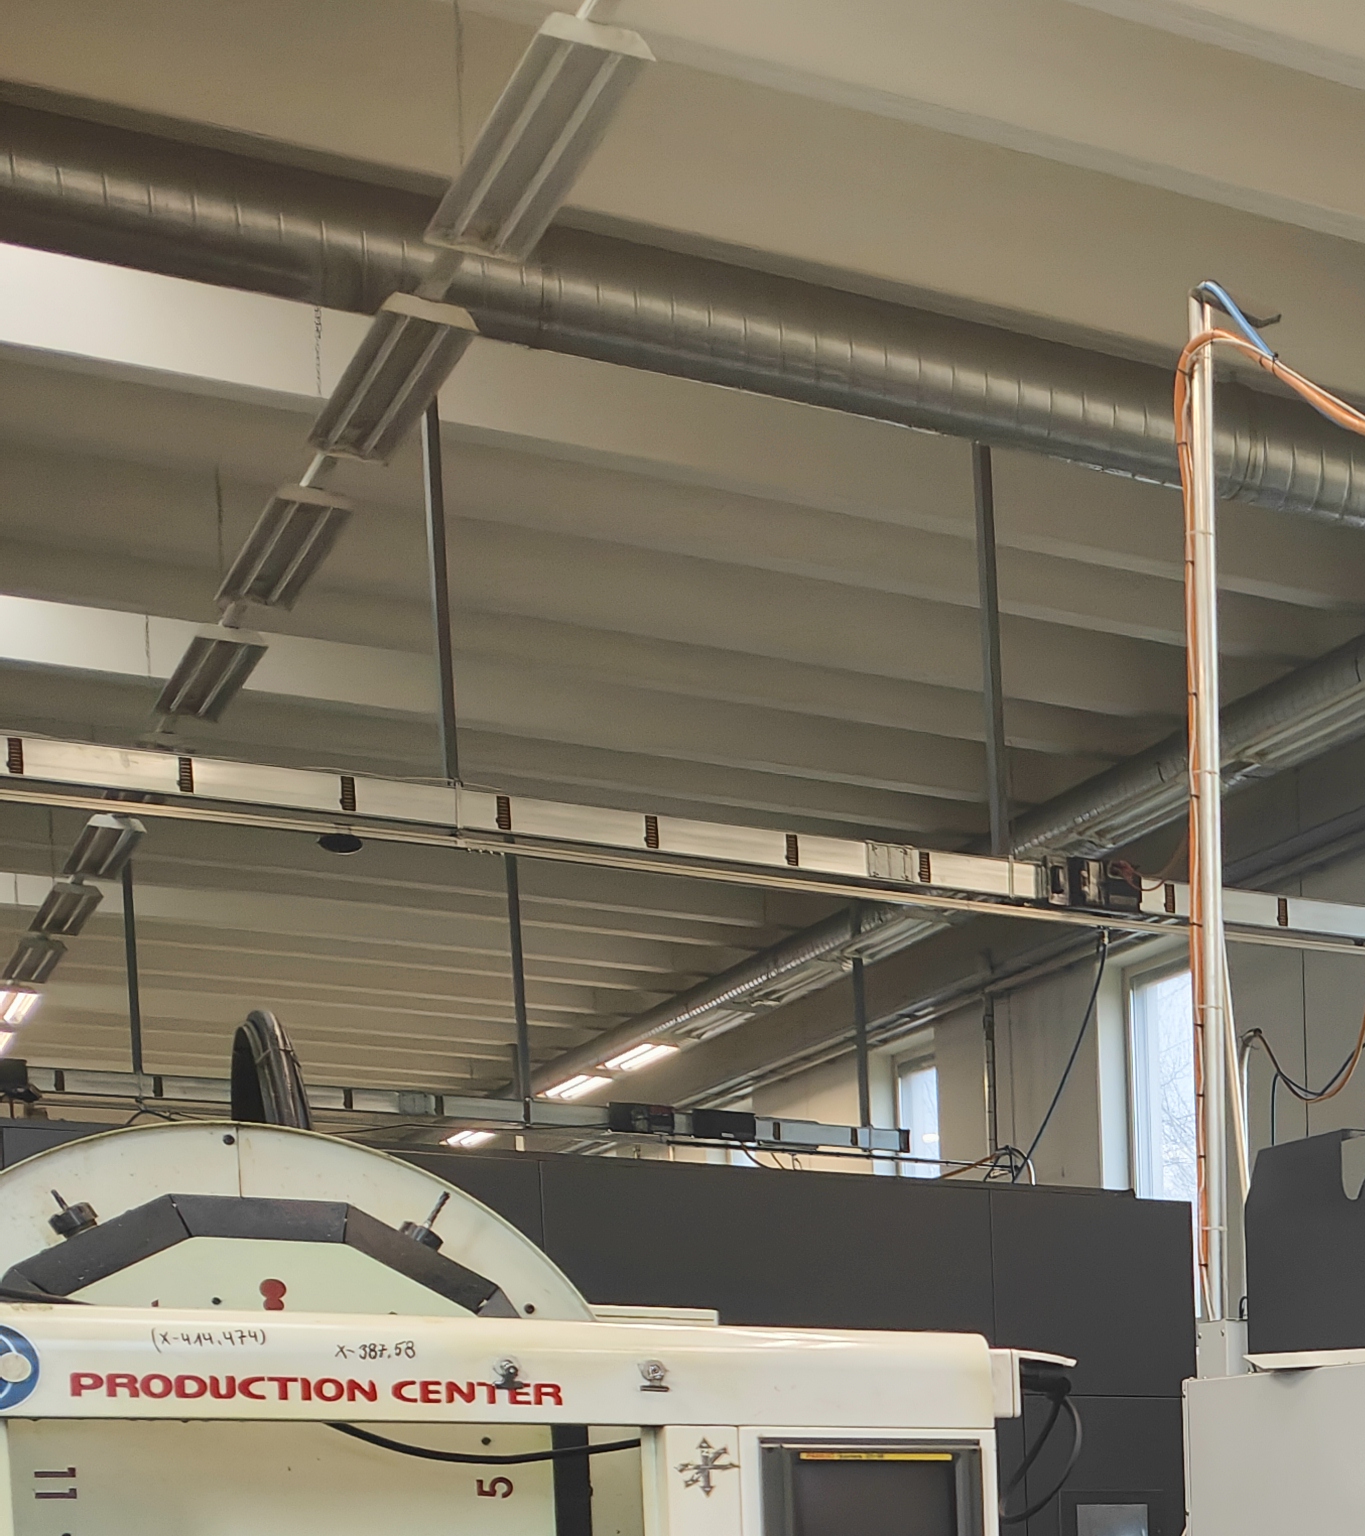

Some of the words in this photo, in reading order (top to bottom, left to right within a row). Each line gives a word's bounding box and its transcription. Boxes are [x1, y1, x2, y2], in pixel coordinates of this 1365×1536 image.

[69, 1371, 378, 1403] PRODUCTION
[391, 1379, 564, 1406] CENTER
[475, 1476, 514, 1499] 5
